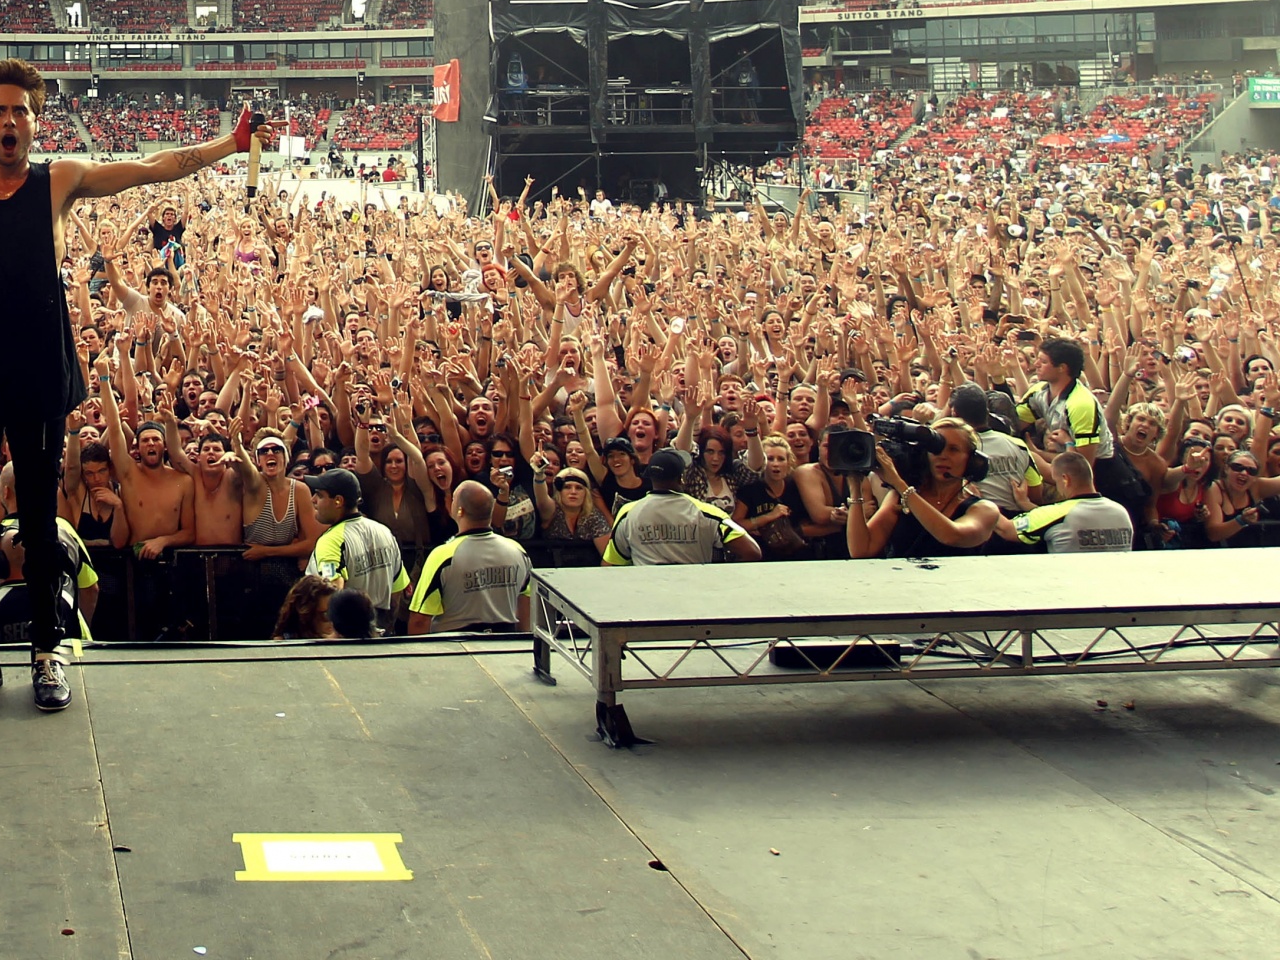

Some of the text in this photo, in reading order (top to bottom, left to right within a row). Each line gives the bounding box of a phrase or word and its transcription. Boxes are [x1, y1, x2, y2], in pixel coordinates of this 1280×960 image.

[837, 9, 923, 20] SUTTOR STAND
[638, 524, 697, 542] SECURITY
[1077, 528, 1132, 546] SECURITY
[464, 565, 520, 589] SECURITY
